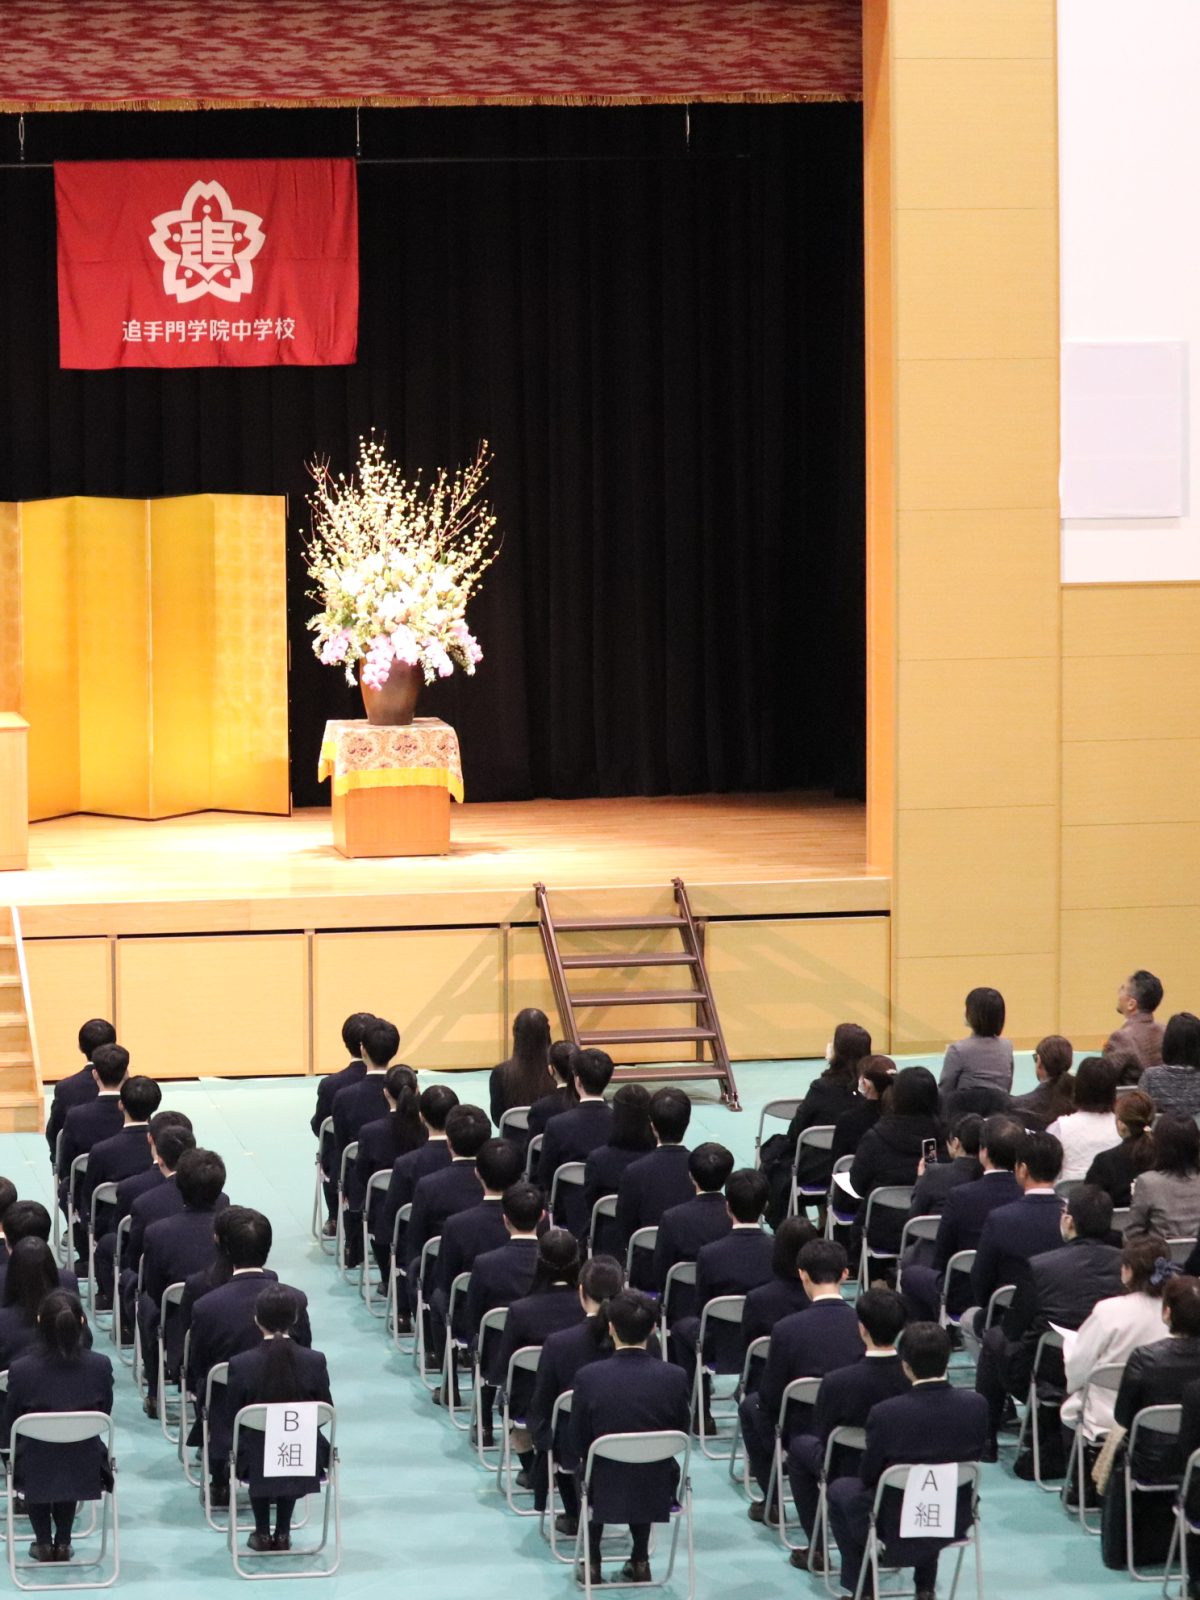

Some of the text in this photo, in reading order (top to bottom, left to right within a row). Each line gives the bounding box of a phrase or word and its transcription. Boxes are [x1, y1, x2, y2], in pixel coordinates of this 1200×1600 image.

[121, 317, 296, 343] 追手門学院中学校
[277, 1410, 304, 1467] B組
[914, 1469, 942, 1528] A組
